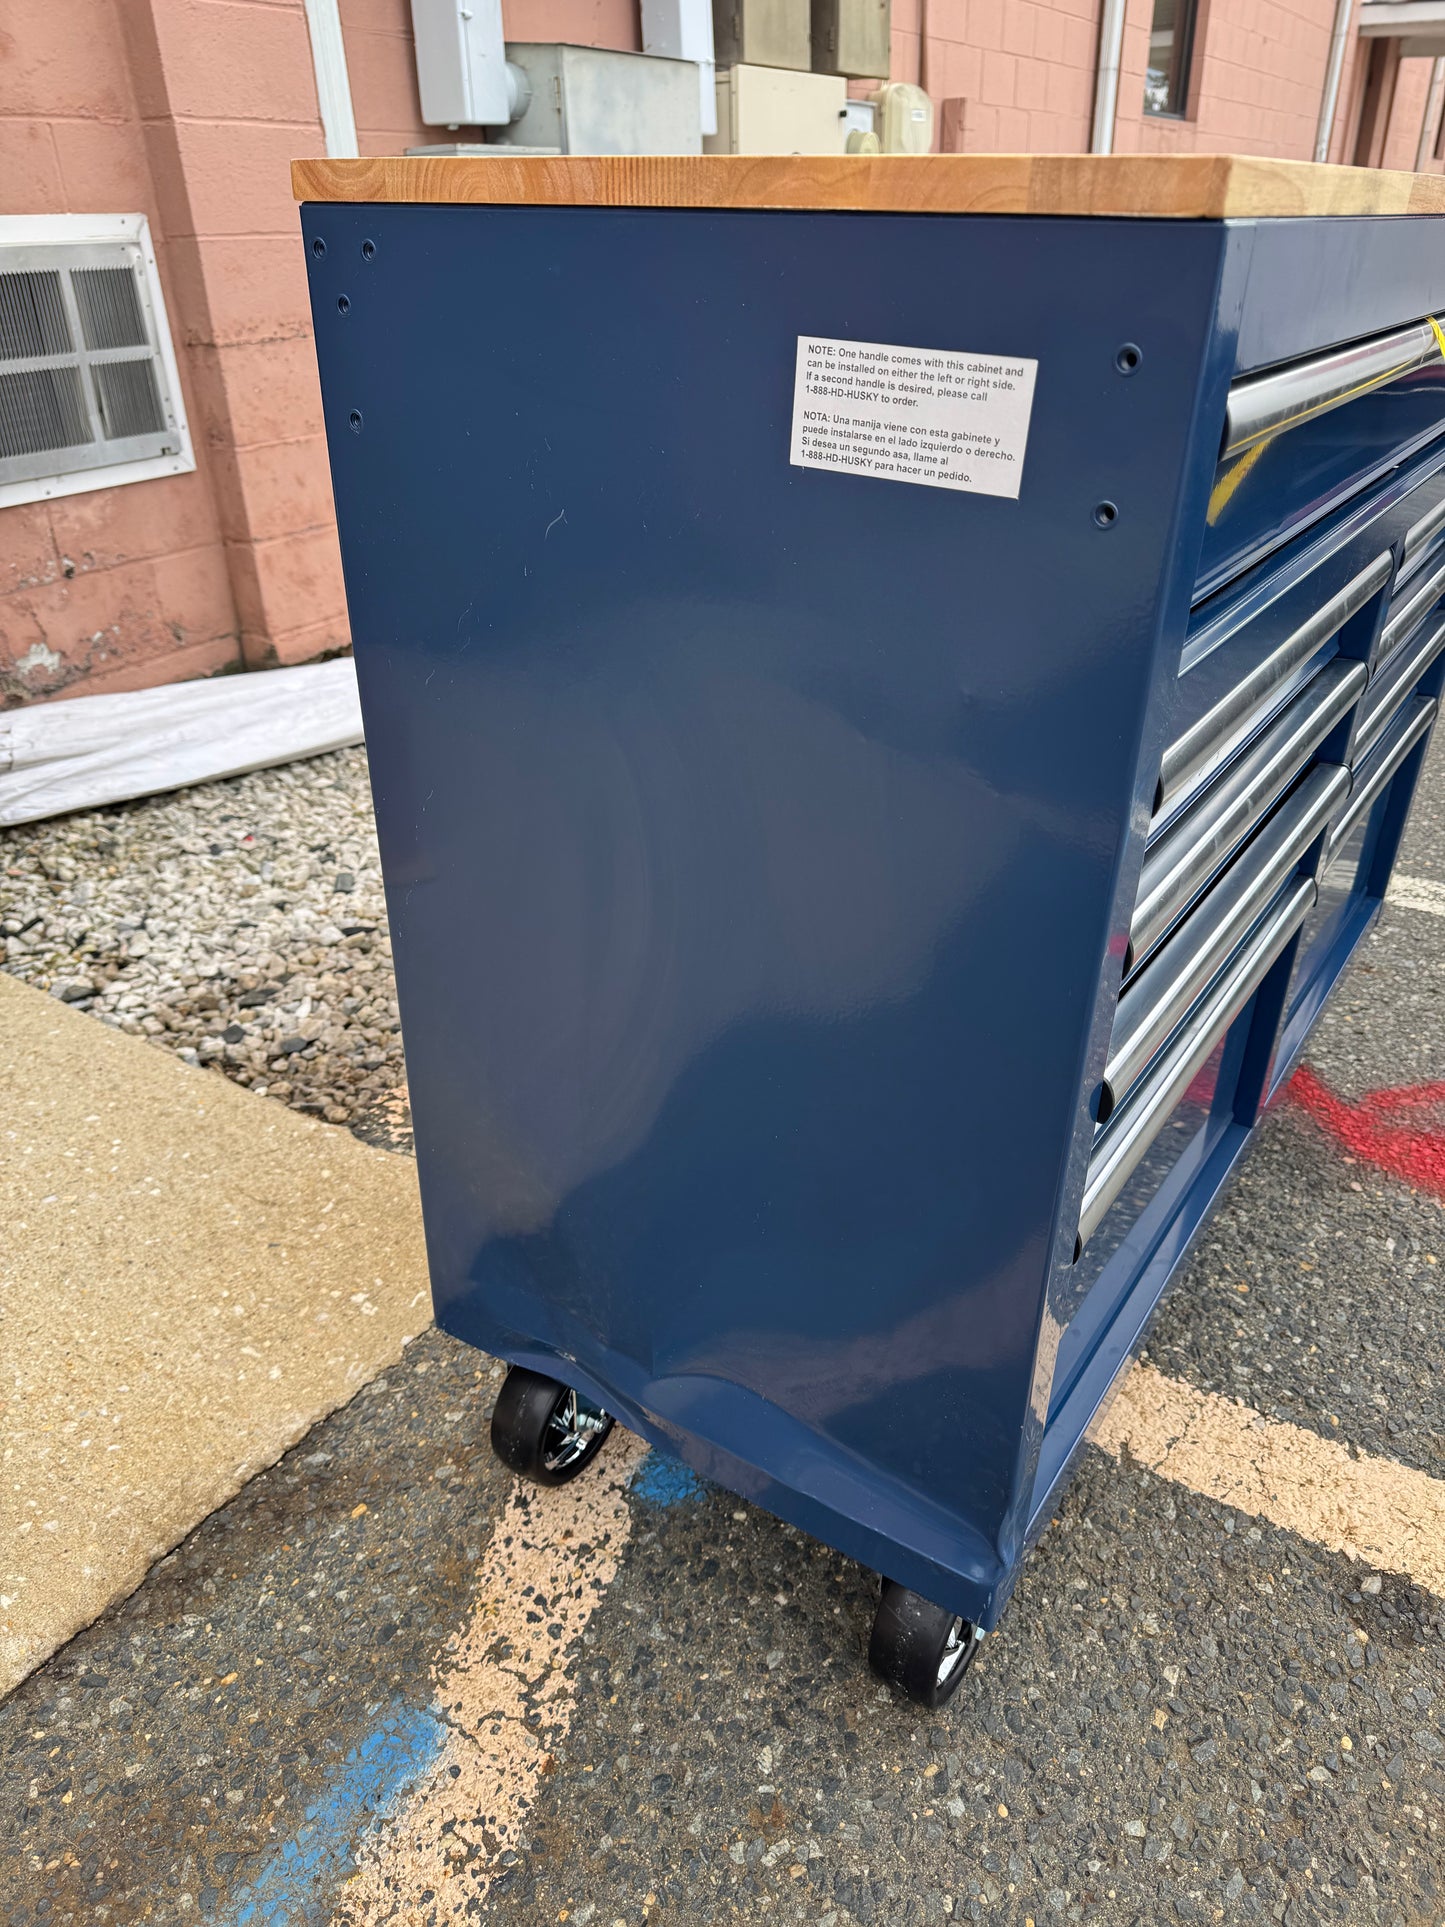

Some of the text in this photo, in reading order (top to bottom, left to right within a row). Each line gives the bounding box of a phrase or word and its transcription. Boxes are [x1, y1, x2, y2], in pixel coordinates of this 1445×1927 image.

[807, 360, 823, 368] can
[825, 359, 836, 370] be
[838, 361, 875, 374] installed
[877, 368, 889, 376] on
[891, 368, 918, 379] either
[920, 371, 935, 381] the
[937, 372, 952, 383] left
[967, 376, 990, 389] right
[992, 379, 1015, 390] side.
[808, 344, 1024, 377] NOTE: One handle comes with this cabinet and
[806, 371, 813, 380] If
[821, 375, 854, 385] second
[855, 377, 885, 389] handle
[888, 380, 896, 390] is
[898, 382, 934, 396] desired,
[937, 387, 968, 399] please
[970, 392, 988, 401] call
[806, 384, 918, 407] 1-888-HD-HUSKY to order.
[802, 425, 828, 435] puede
[830, 427, 873, 441] instalarse
[874, 435, 886, 443] en
[888, 435, 896, 445] el
[898, 436, 918, 448] lado
[920, 439, 963, 454] izquierdo
[974, 447, 1015, 461] derecho.
[803, 410, 830, 423] NOTA:
[833, 414, 850, 425] Una
[852, 419, 881, 431] manija
[883, 422, 908, 433] viene
[910, 427, 927, 435] con
[929, 429, 949, 439] esta
[951, 432, 992, 444] gabinete
[801, 449, 972, 482] 1-888-HD-HUSKY para hacer un pedido.
[811, 438, 837, 450] desea
[839, 443, 850, 452] un
[852, 445, 891, 457] segundo
[892, 451, 910, 461] asa,
[913, 452, 938, 464] llame
[940, 456, 949, 465] al
